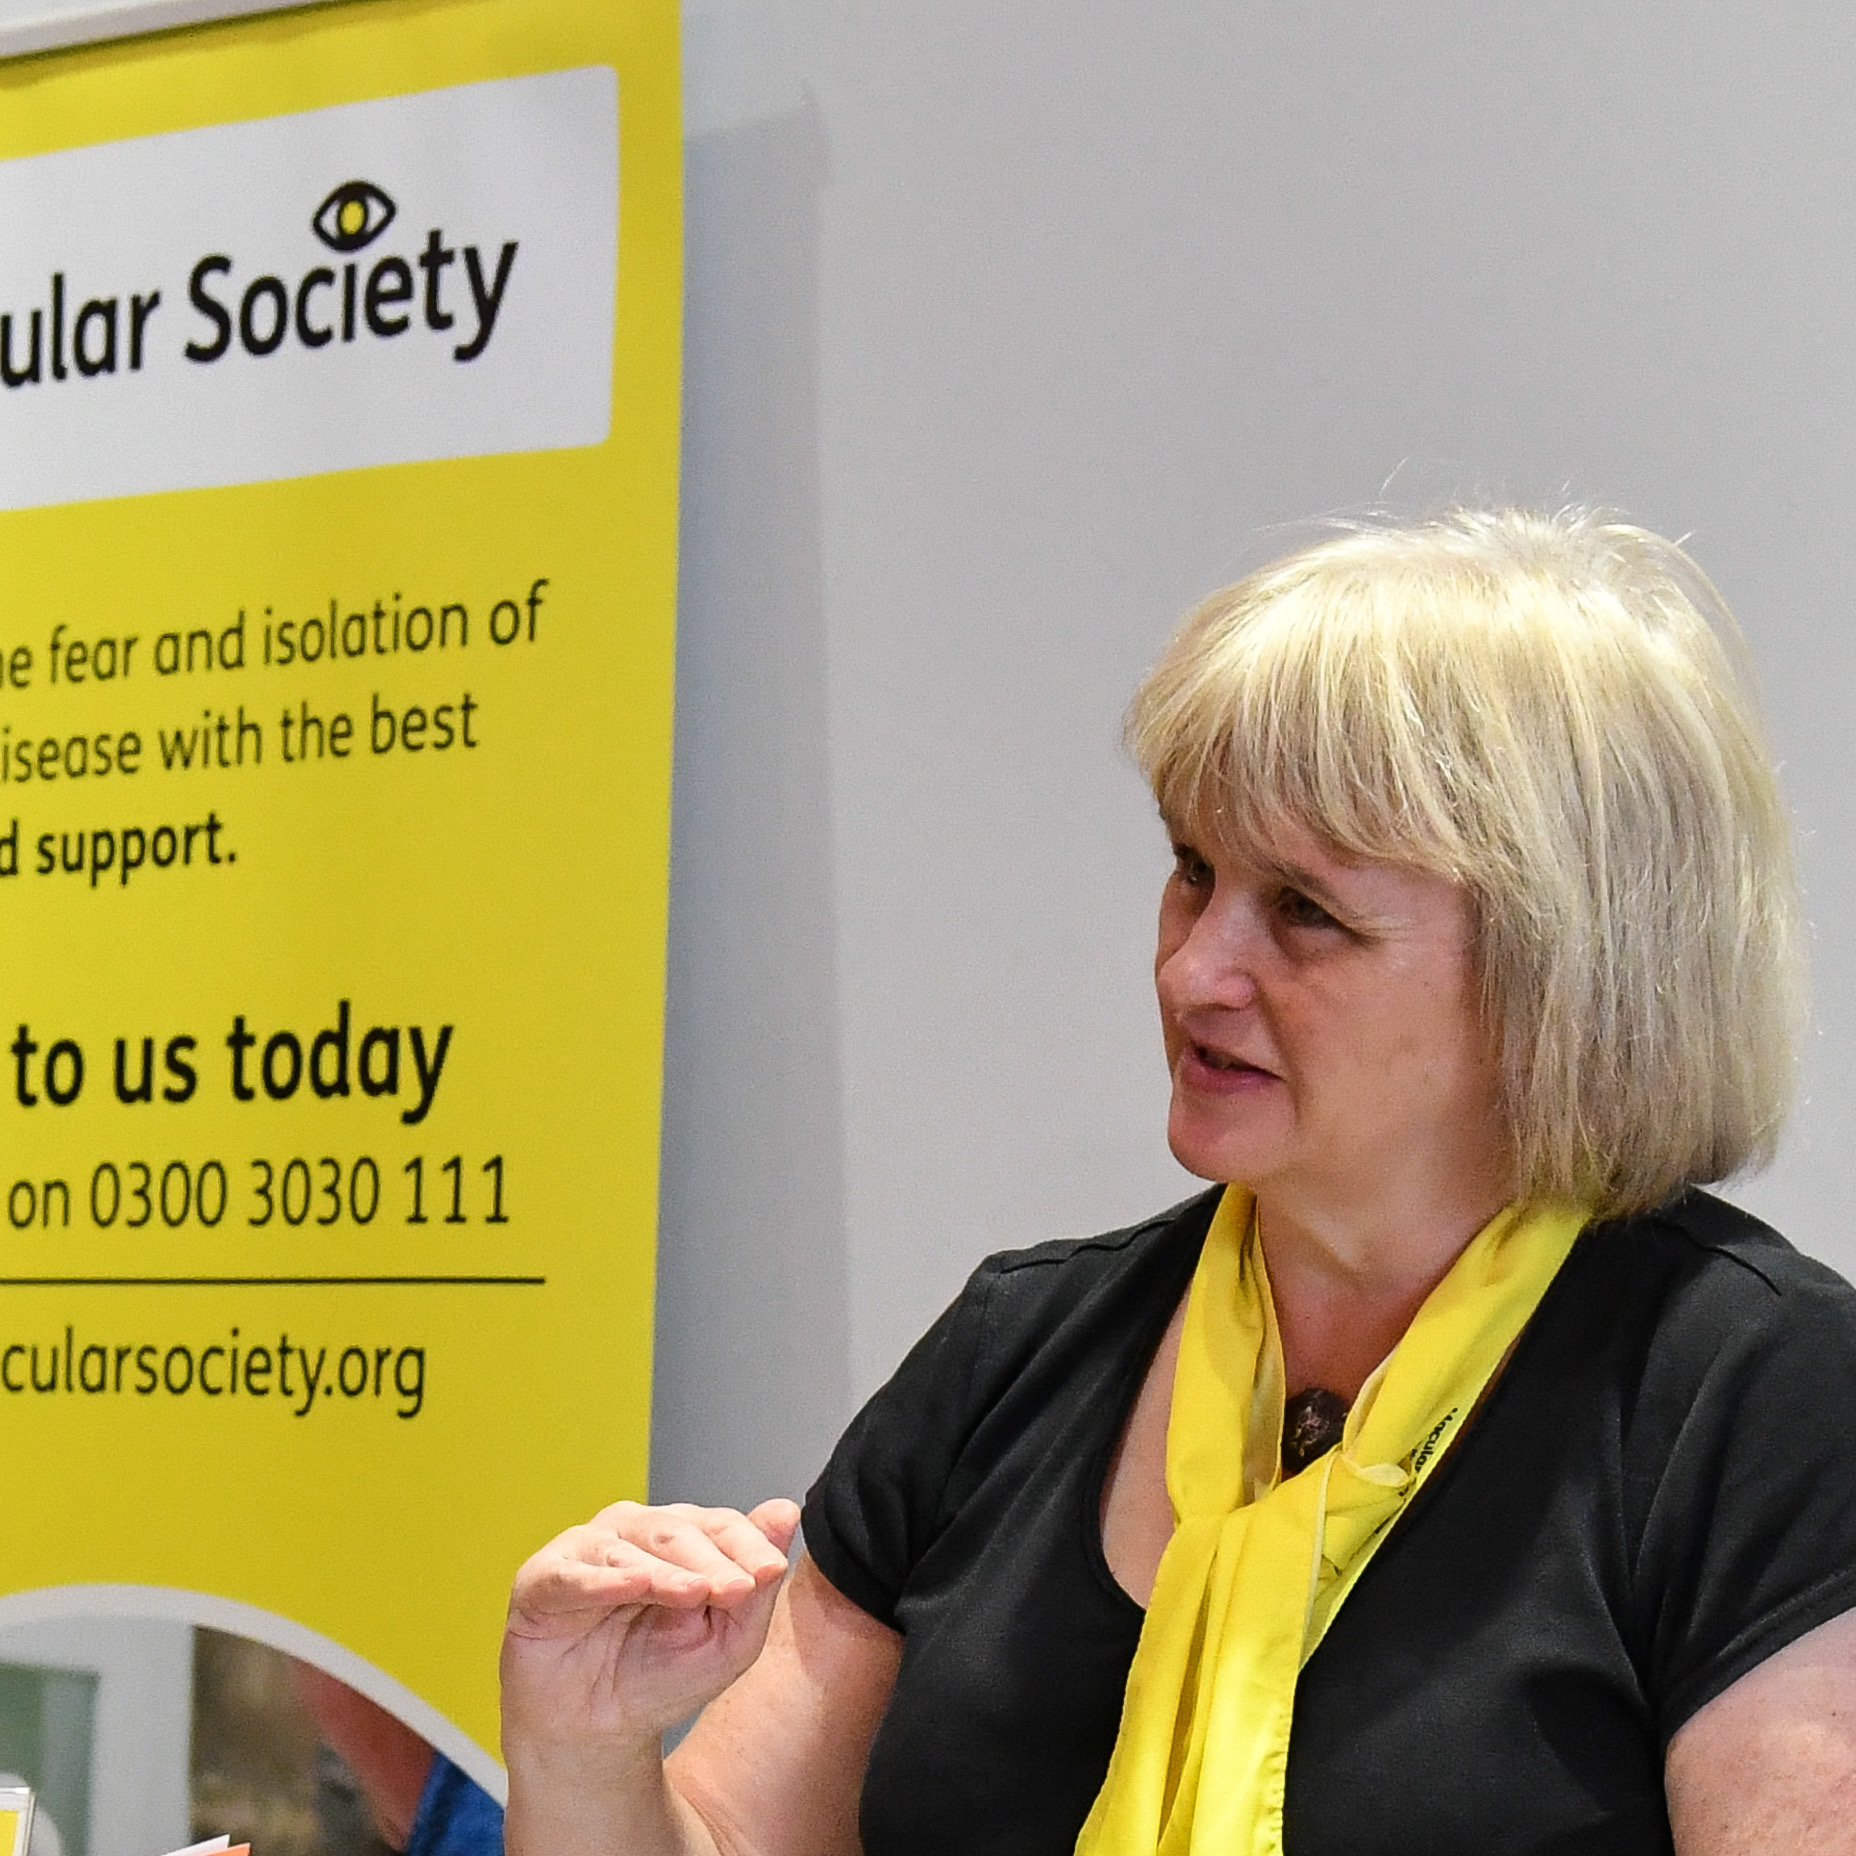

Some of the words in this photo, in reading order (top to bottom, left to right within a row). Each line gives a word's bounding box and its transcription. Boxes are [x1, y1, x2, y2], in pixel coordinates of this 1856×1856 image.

[183, 229, 519, 365] Society
[48, 622, 140, 685] fear
[152, 608, 246, 677] and
[262, 590, 469, 667] isolation
[488, 576, 551, 647] of
[157, 704, 263, 772] with
[278, 699, 355, 764] the
[369, 691, 479, 756] best
[35, 811, 237, 890] support.
[9, 1023, 85, 1109] to
[113, 1034, 198, 1106] us
[224, 998, 454, 1127] today
[7, 1178, 71, 1231] on
[89, 1158, 229, 1230] 0300
[247, 1154, 381, 1228] 3030
[402, 1153, 510, 1226] 111
